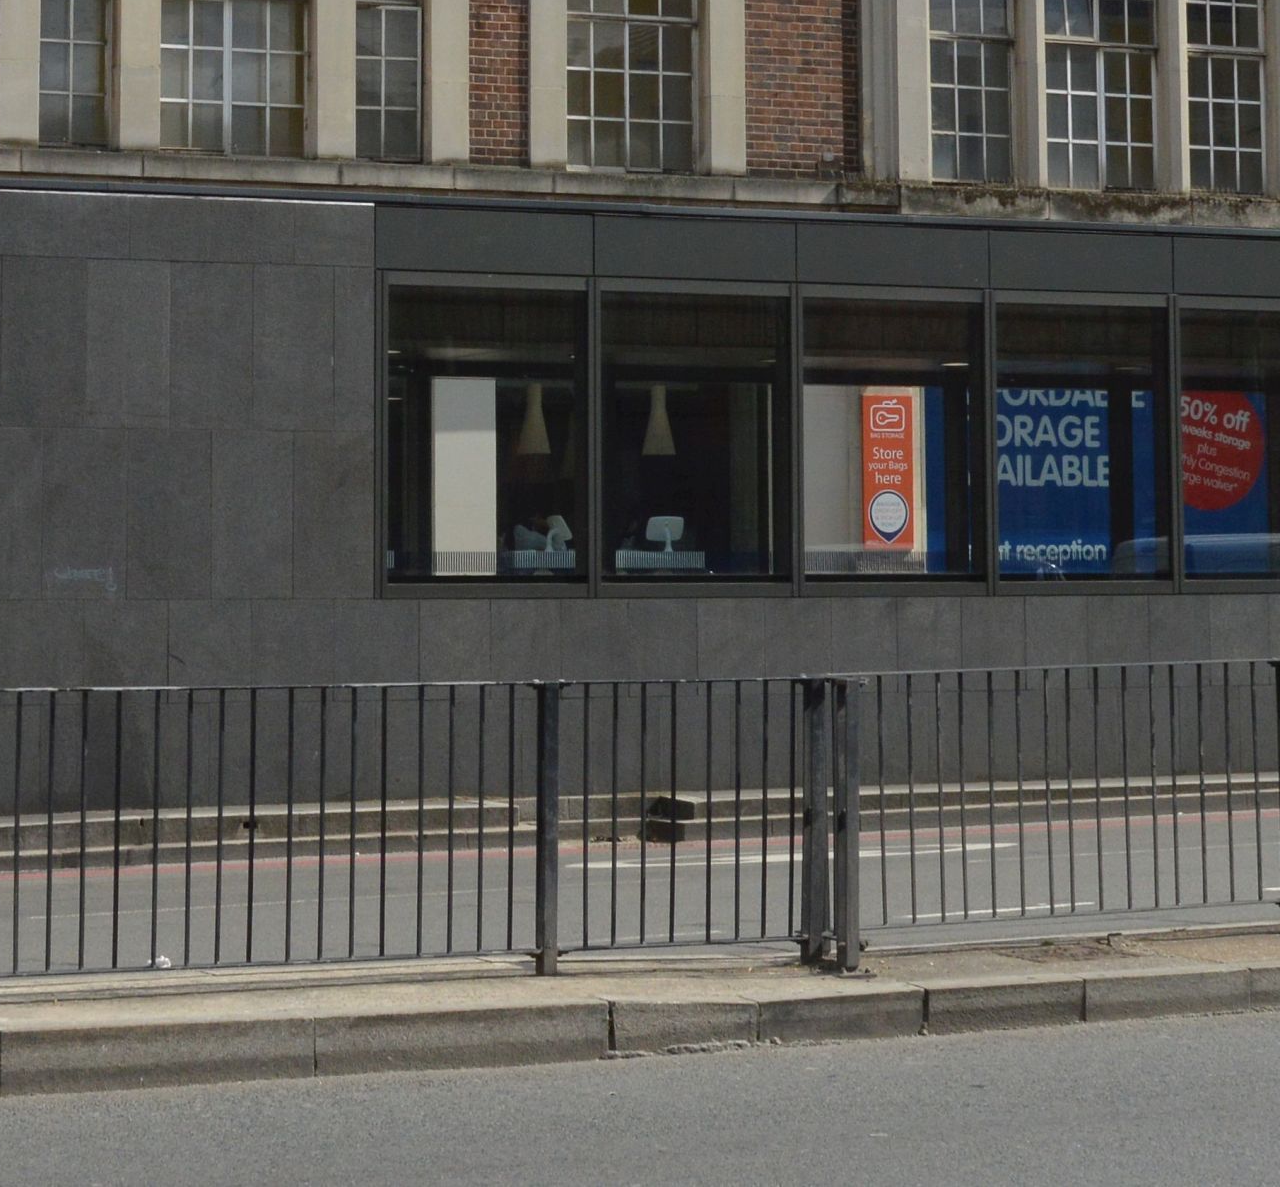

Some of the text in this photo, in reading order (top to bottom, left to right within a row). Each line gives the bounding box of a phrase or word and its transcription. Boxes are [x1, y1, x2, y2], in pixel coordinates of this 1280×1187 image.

[1180, 395, 1251, 433] 50% off
[1182, 424, 1252, 450] weeks storage
[872, 446, 904, 460] Store
[1196, 442, 1218, 456] plus
[868, 461, 908, 472] your Bags
[1198, 457, 1251, 480] Congestion
[875, 471, 902, 485] here
[1016, 538, 1107, 566] reception
